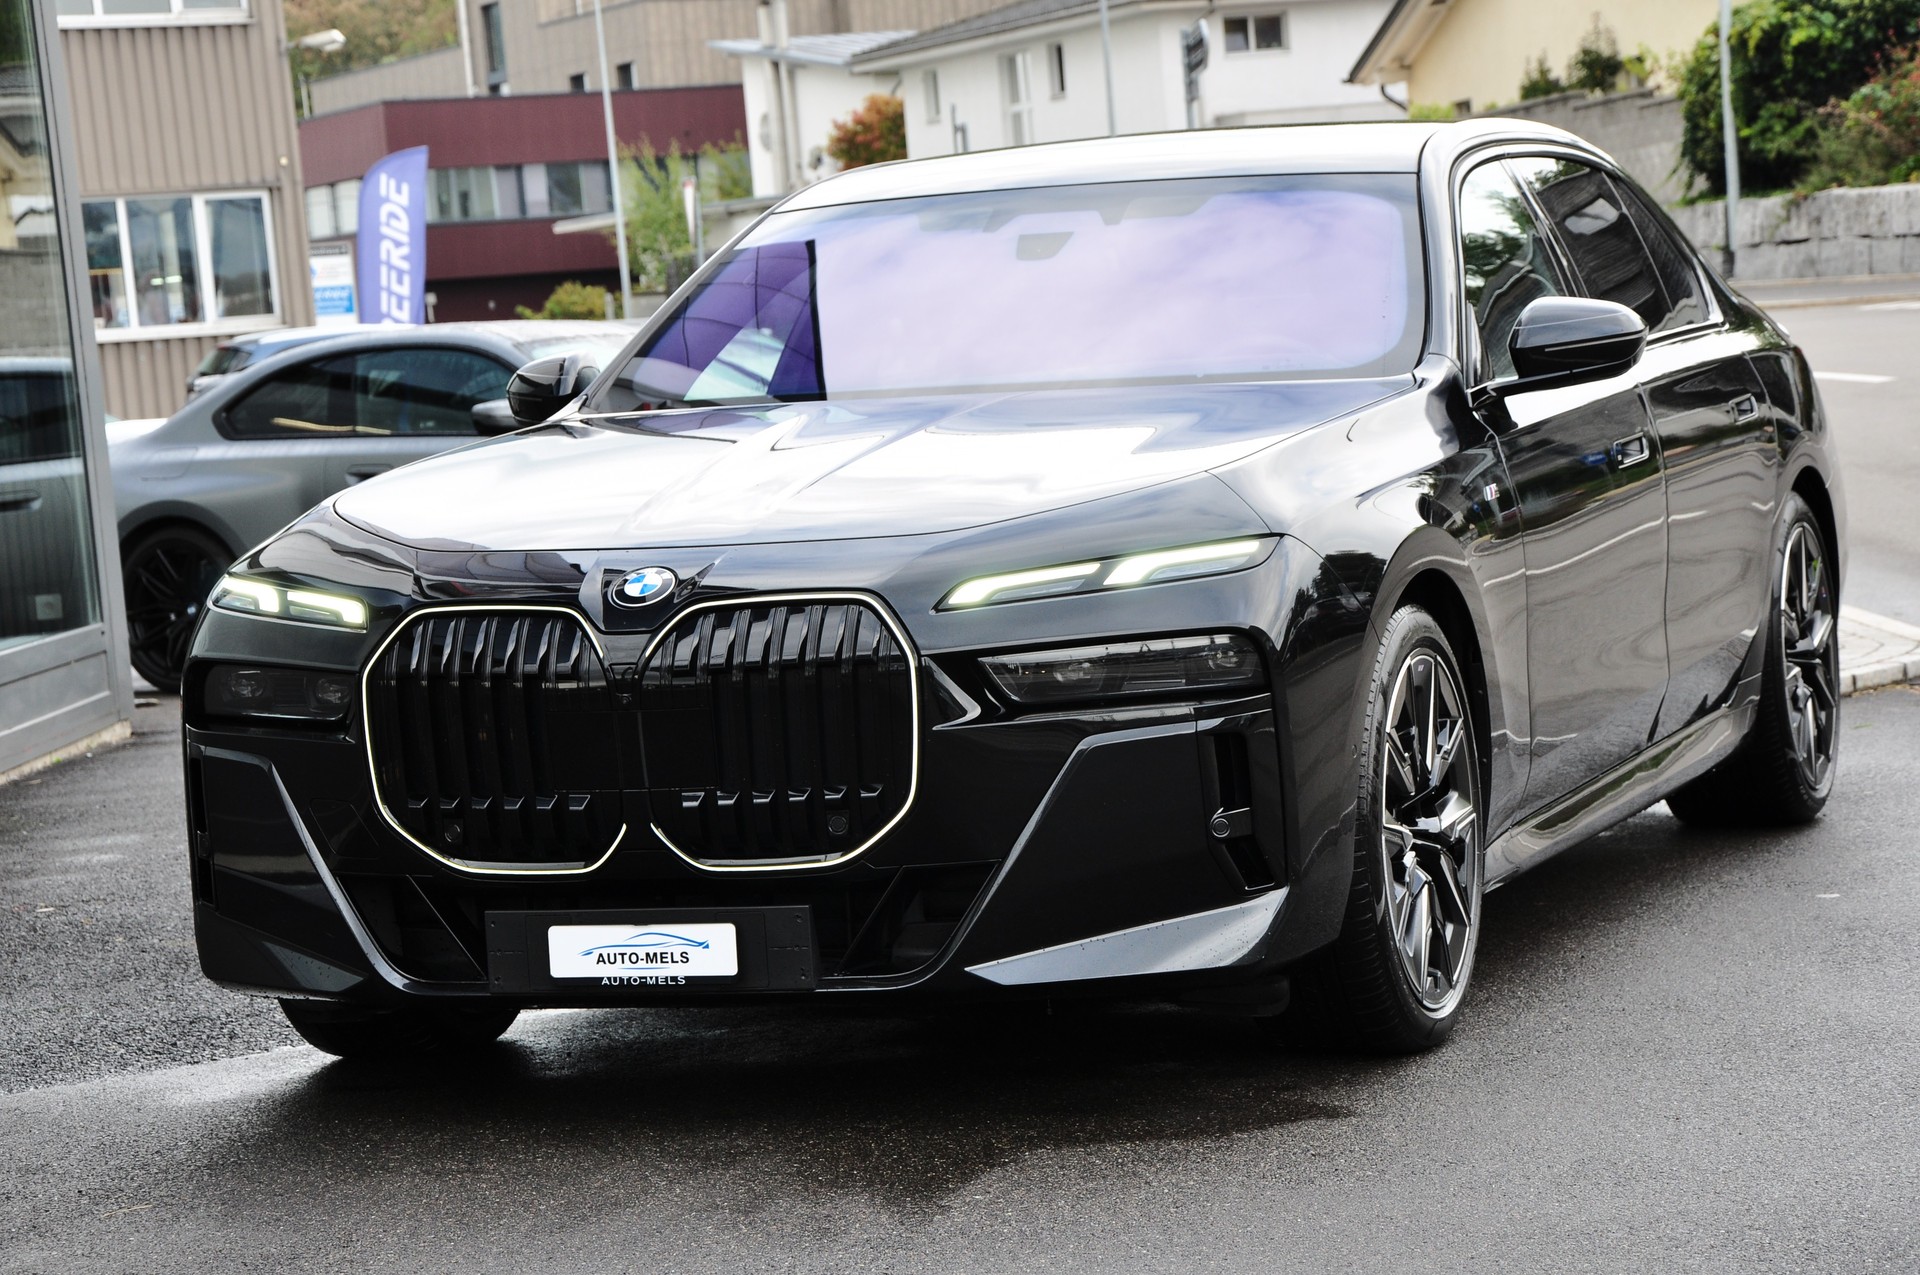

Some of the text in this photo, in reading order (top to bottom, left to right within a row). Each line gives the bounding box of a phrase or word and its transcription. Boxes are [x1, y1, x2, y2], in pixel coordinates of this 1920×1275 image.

[379, 172, 411, 324] EERIDE
[596, 951, 689, 964] AUTO-MELS
[601, 976, 685, 985] AUTO-MELS
